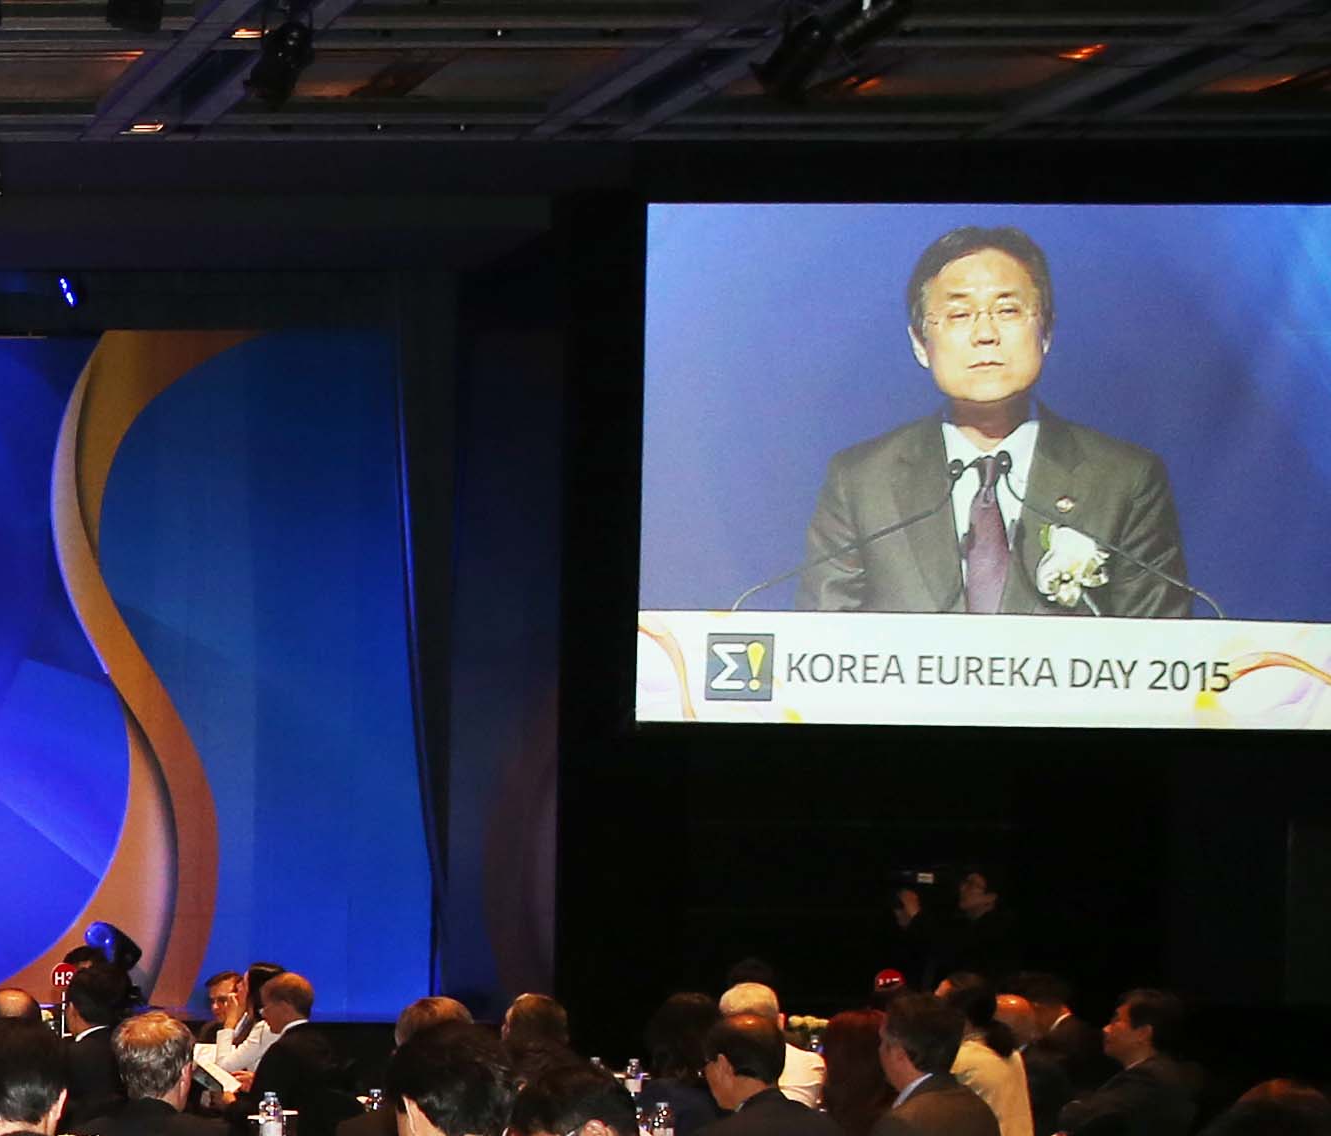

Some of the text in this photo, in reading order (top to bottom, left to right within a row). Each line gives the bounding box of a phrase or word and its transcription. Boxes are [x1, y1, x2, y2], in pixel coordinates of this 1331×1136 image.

[786, 652, 1232, 692] KOREA EUREKA DAY 2015
[54, 971, 74, 986] H3
